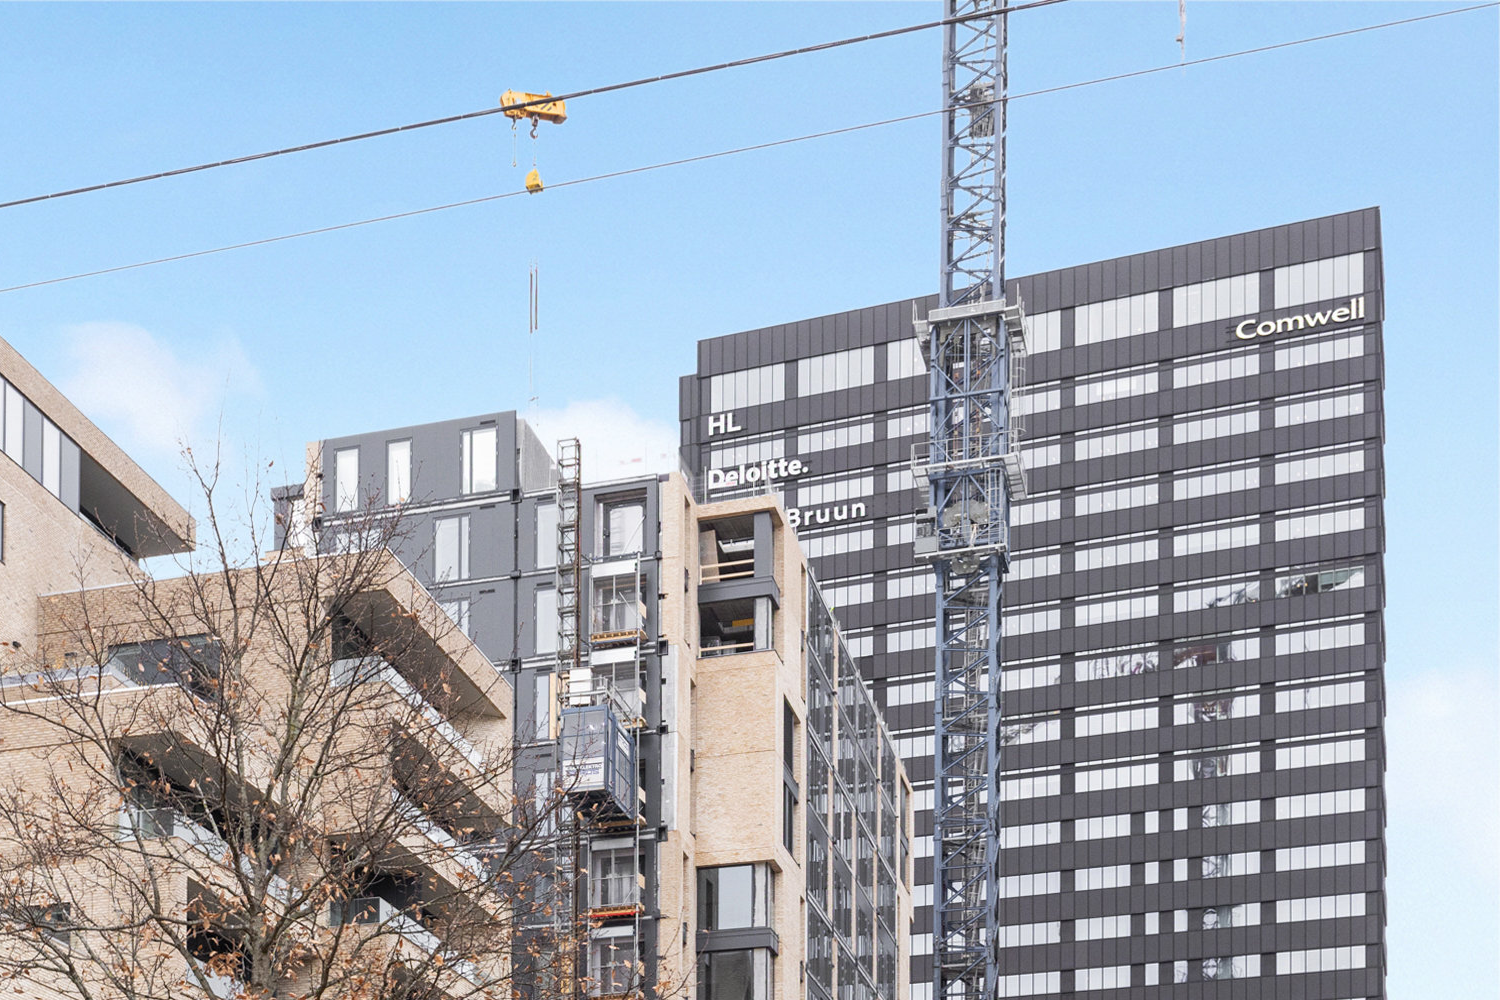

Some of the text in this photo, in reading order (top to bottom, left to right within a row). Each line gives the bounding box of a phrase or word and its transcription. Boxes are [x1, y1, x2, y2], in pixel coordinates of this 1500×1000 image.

[1235, 296, 1365, 340] Comwell
[708, 412, 742, 436] HL
[708, 457, 809, 490] Deloitte.
[786, 501, 866, 528] Bruun
